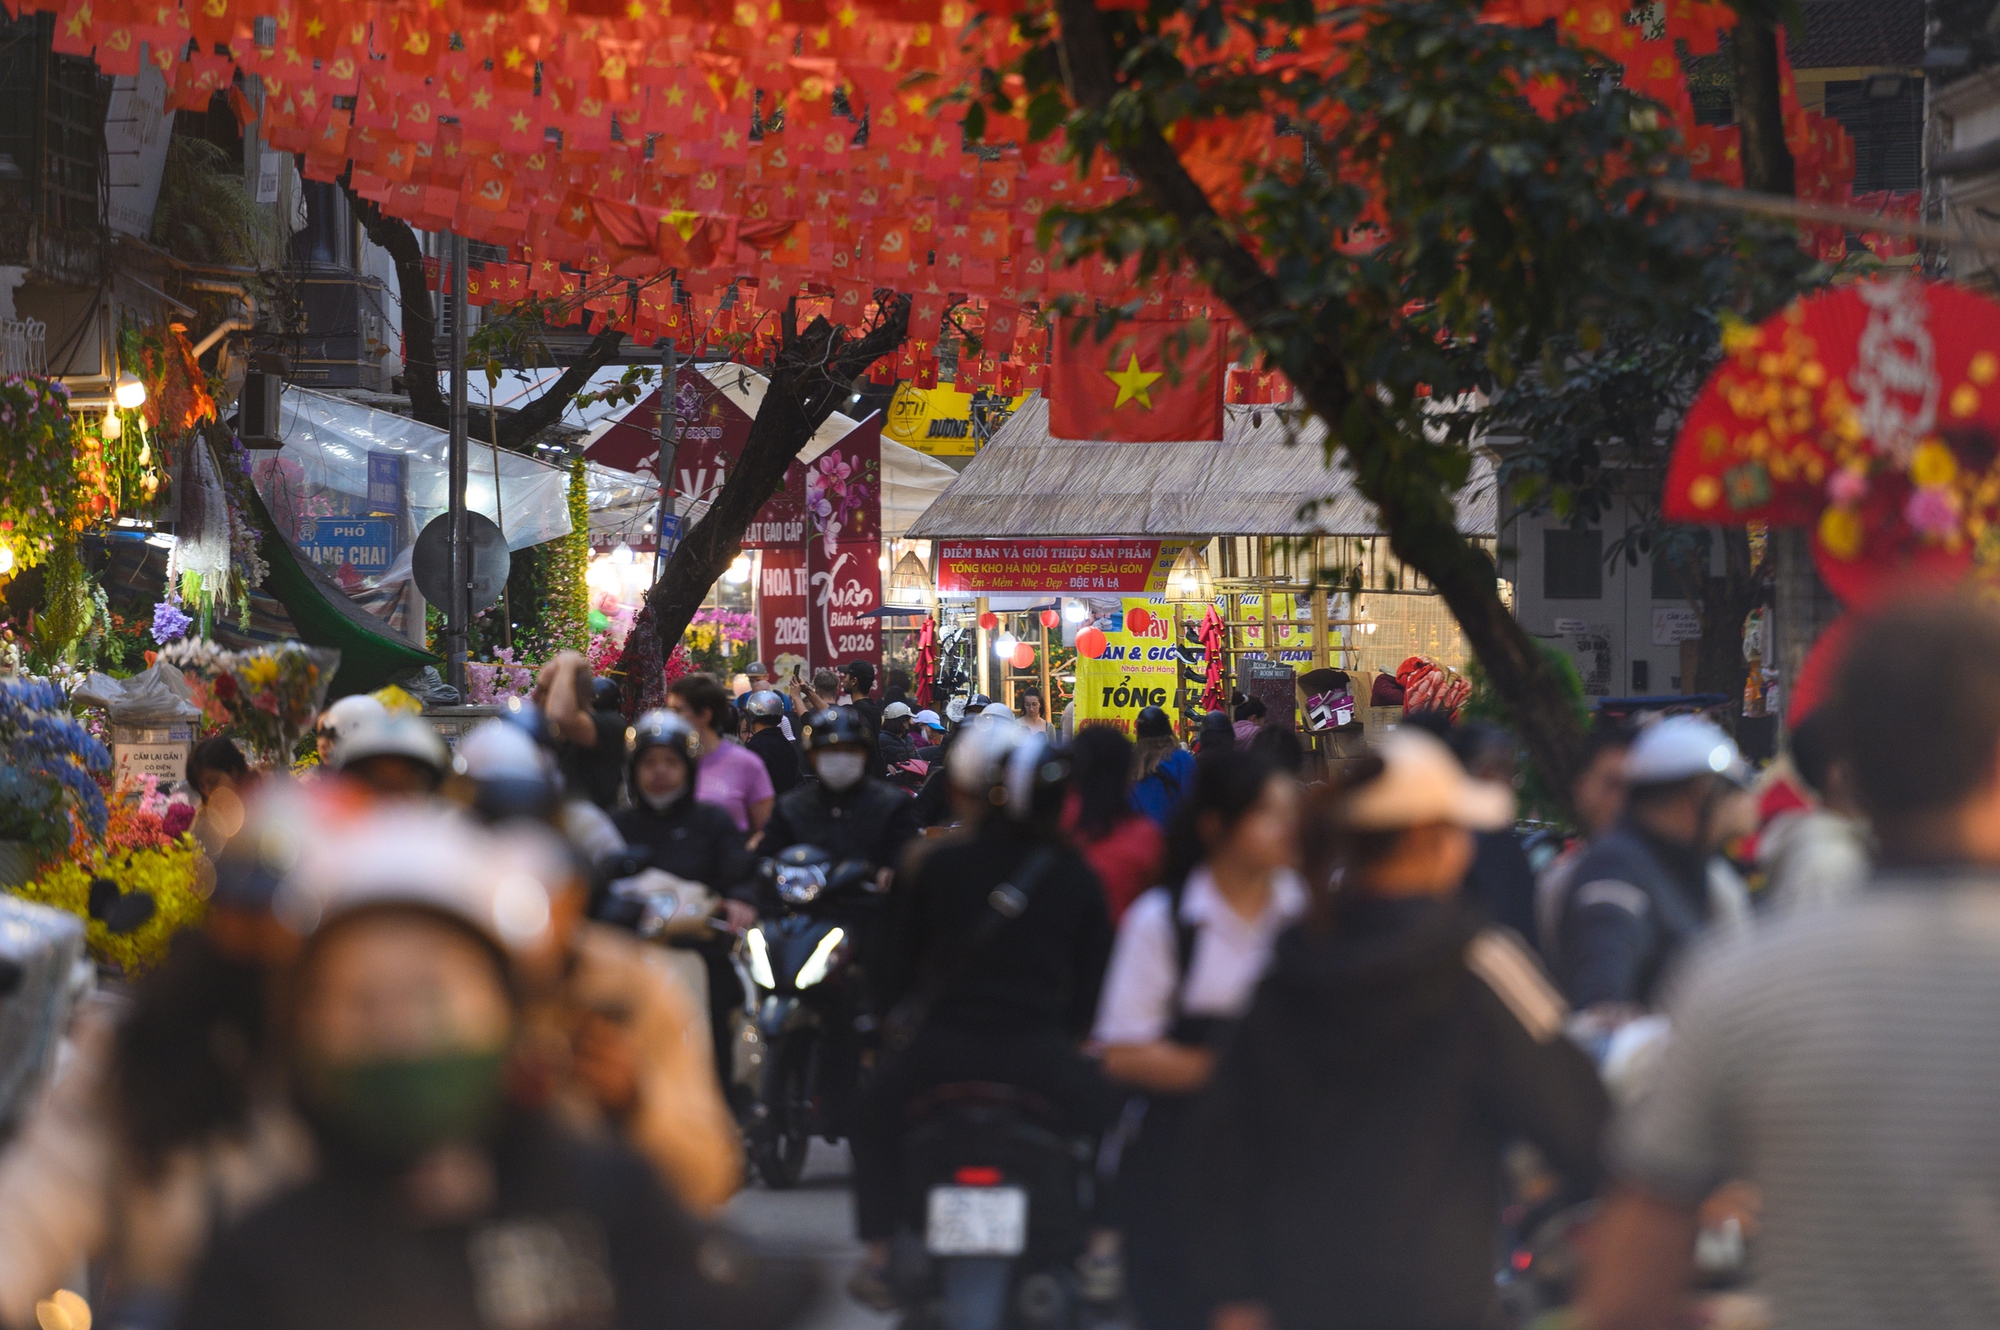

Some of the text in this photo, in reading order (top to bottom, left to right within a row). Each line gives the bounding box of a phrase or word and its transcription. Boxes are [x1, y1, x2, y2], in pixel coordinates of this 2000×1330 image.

[686, 426, 723, 440] ORCHID
[334, 523, 366, 537] PHỐ
[763, 522, 783, 542] CAO
[784, 514, 803, 542] CẤP
[349, 546, 386, 565] CHAI
[943, 542, 1152, 561] ĐIỂM BÁN VÀ GIỚI THIỆU SẢN PHẨM
[981, 563, 1003, 573] KHO
[1005, 561, 1020, 573] HÀ
[1022, 563, 1041, 575] NỘI
[1075, 561, 1097, 574] DÉP
[1100, 561, 1119, 574] SÀI
[1120, 561, 1144, 574] GÒN
[763, 562, 808, 596] HOA TẾ
[971, 575, 985, 588] Êm
[992, 575, 1013, 588] Mềm
[1021, 577, 1039, 590] Nhẹ
[1046, 577, 1063, 590] Đẹp
[1070, 576, 1090, 590] ĐỘC
[1092, 577, 1105, 588] VÀ
[1107, 577, 1119, 590] LẠ
[811, 552, 874, 659] Xuân
[775, 617, 808, 645] 2026
[838, 634, 875, 653] 2026
[1092, 642, 1125, 661] ÁN
[1128, 646, 1142, 660] &
[1121, 665, 1175, 675] Nhận Đặt Hàng
[1102, 675, 1166, 708] TỔNG
